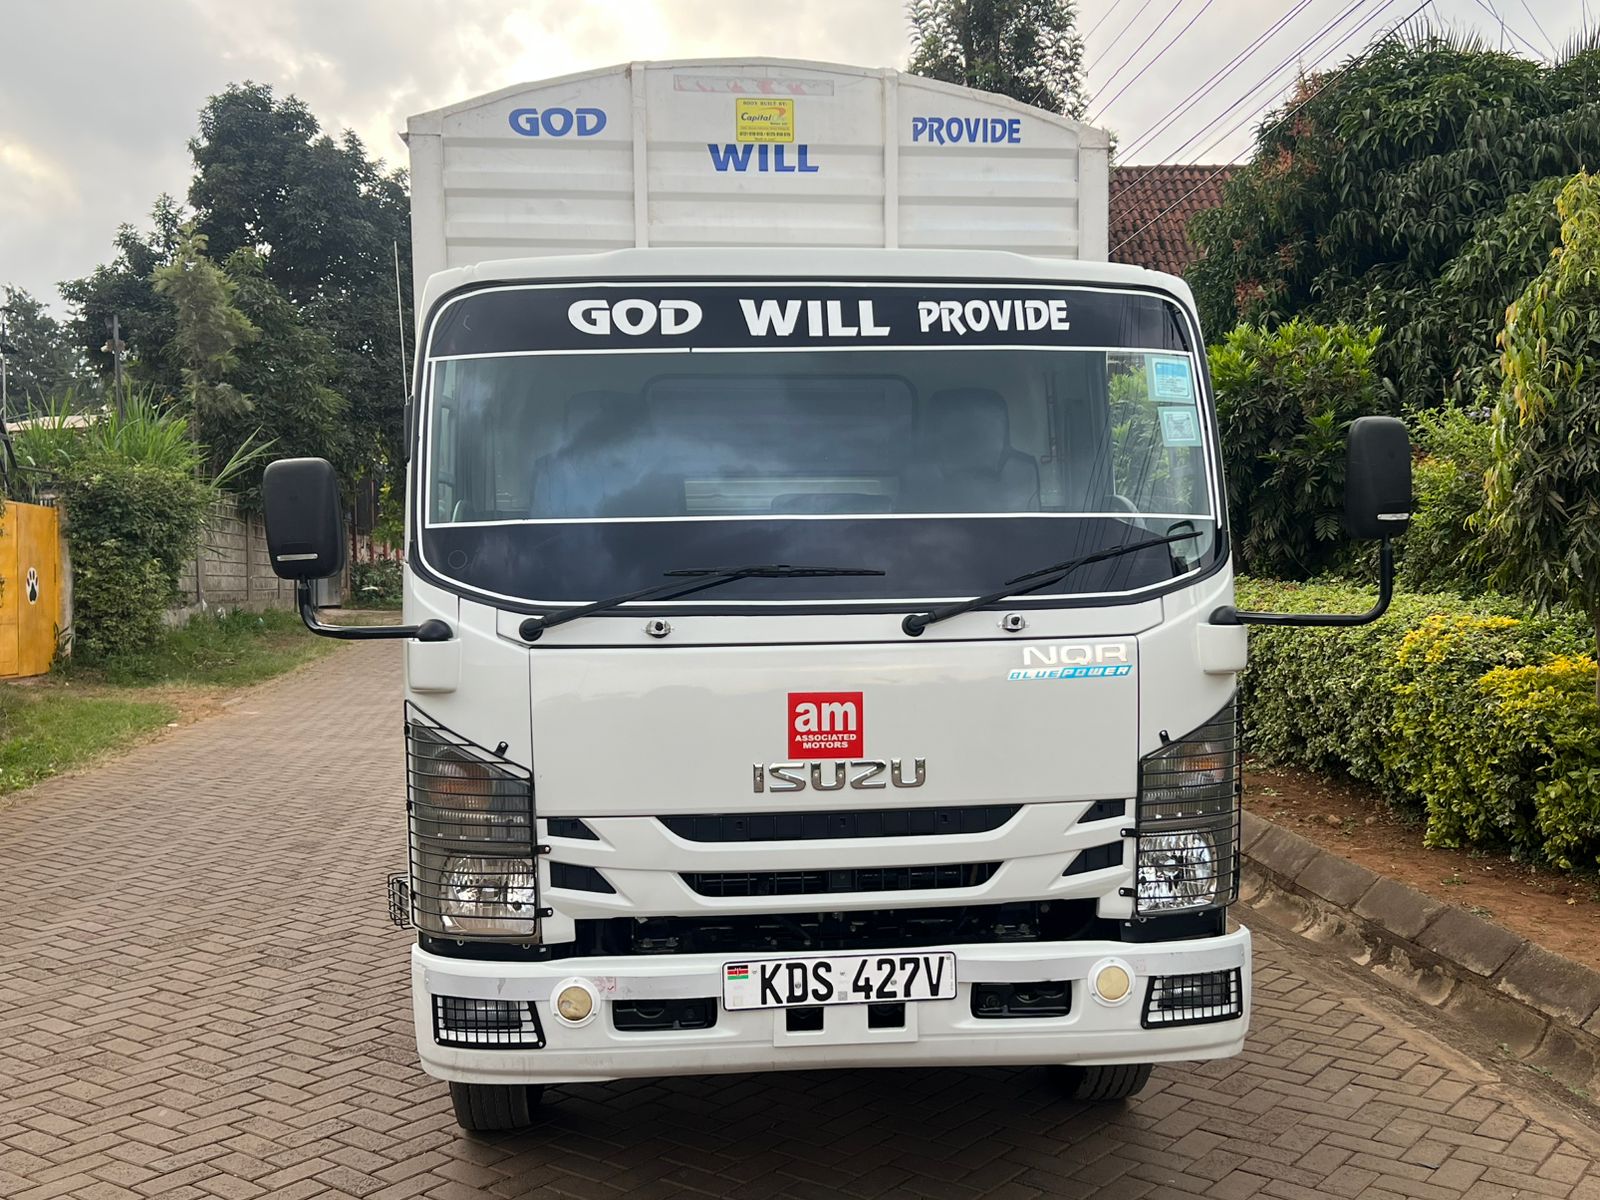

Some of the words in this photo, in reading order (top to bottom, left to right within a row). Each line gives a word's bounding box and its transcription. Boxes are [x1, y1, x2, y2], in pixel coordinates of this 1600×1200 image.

[508, 107, 607, 137] GOD
[741, 112, 772, 122] Capital
[912, 117, 1021, 145] PROVIDE
[707, 143, 819, 172] WILL
[567, 298, 703, 336] GOD
[738, 299, 891, 337] WILL
[917, 299, 1070, 336] PROVIDE
[1022, 643, 1128, 666] NQR
[794, 701, 857, 732] am
[794, 733, 857, 742] ASSOCIATED
[802, 741, 849, 749] MOTORS
[753, 757, 926, 793] ISUZU
[760, 961, 834, 1005] KDS
[852, 956, 945, 1000] 427V
